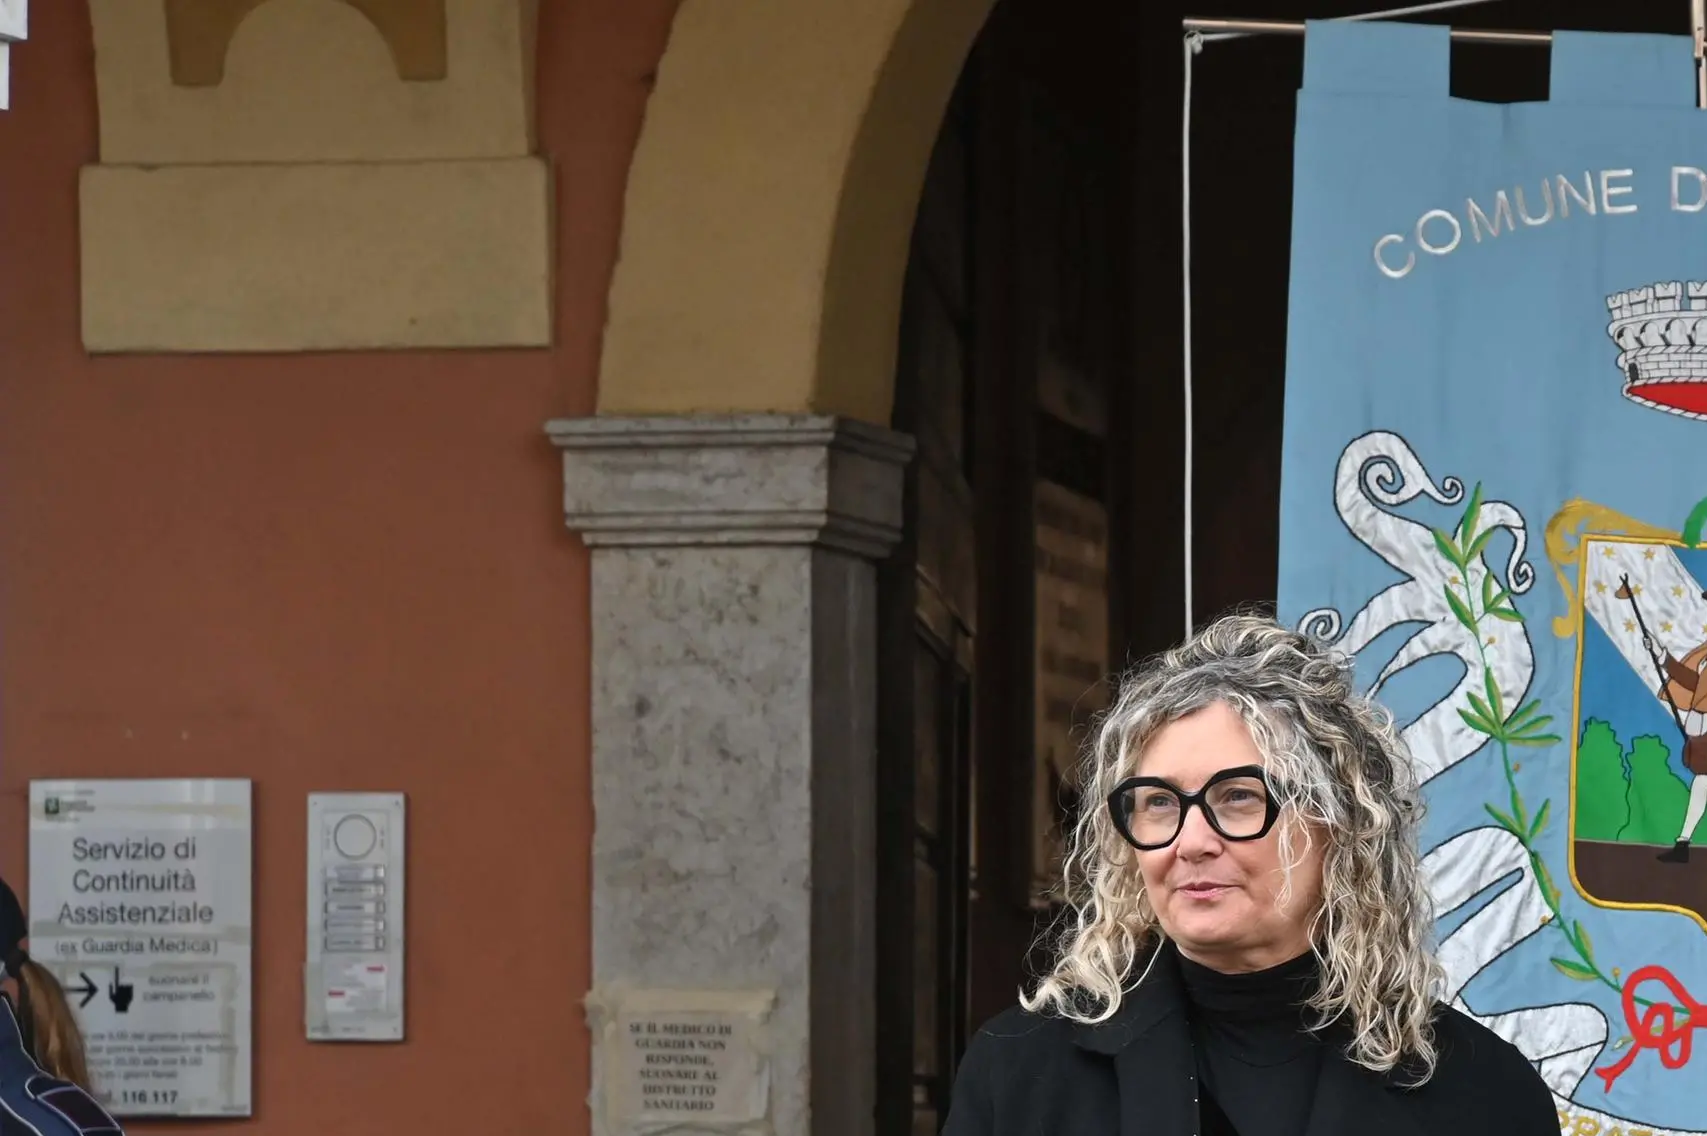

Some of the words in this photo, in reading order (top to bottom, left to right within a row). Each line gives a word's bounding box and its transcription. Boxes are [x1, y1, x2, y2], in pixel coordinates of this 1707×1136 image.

[1374, 168, 1638, 278] COMUNE
[72, 837, 166, 861] Servizio
[174, 837, 196, 860] di
[72, 869, 196, 893] Continuità
[58, 901, 214, 925] Assistenziale
[55, 940, 78, 955] (ex
[82, 937, 144, 954] Guardia
[150, 936, 218, 955] Medica)
[647, 1022, 658, 1034] IL
[662, 1023, 716, 1035] MEDICO
[719, 1024, 732, 1035] DI
[635, 1038, 695, 1049] GUARDIA
[698, 1040, 727, 1050] NON
[640, 1069, 697, 1080] SUONARE
[122, 1090, 147, 1104] 116
[153, 1090, 178, 1104] 117
